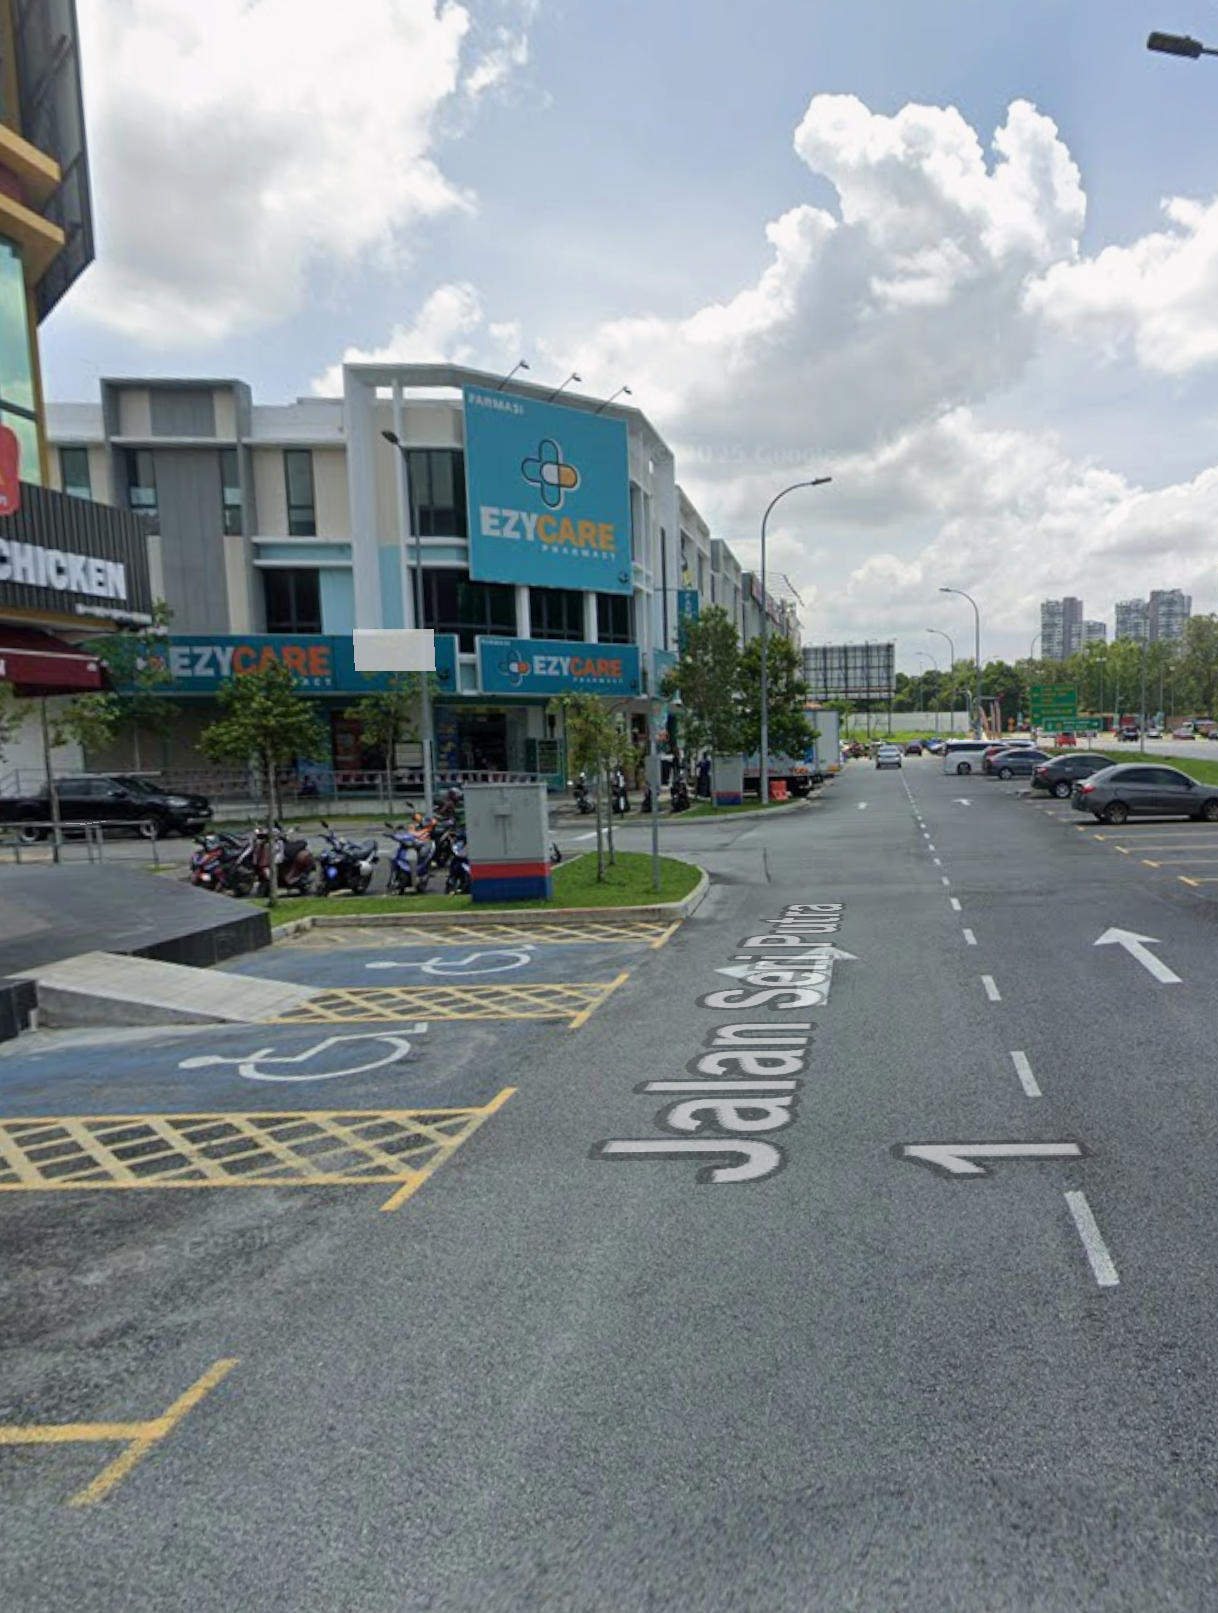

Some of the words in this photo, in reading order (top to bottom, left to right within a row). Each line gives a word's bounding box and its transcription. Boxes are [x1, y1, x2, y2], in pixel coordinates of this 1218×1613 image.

[480, 506, 616, 551] EZYCARE
[168, 645, 331, 678] EZYCARE
[532, 655, 622, 677] EZYCARE
